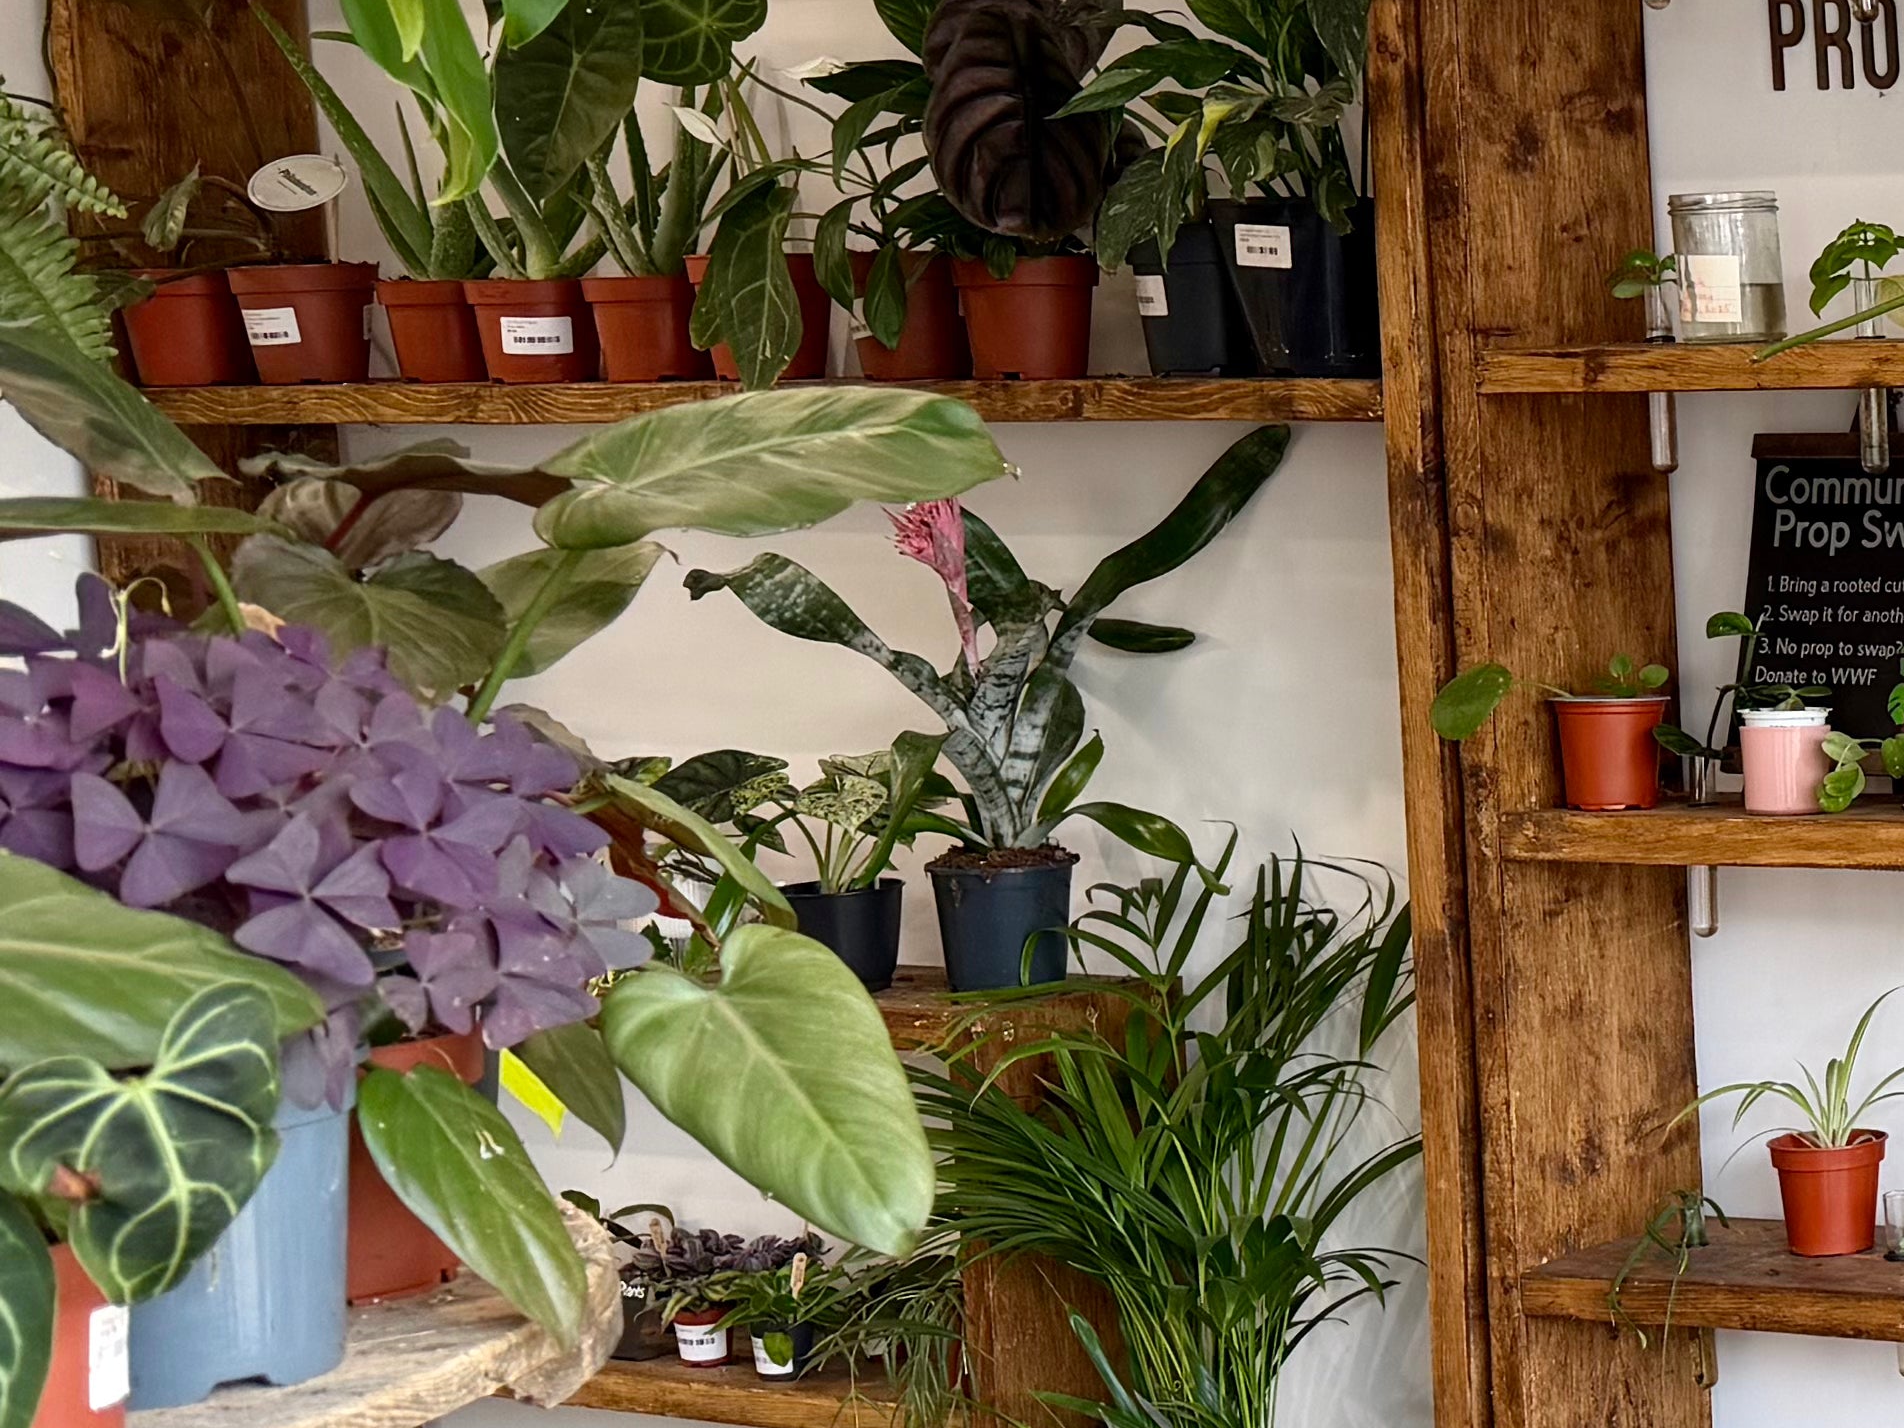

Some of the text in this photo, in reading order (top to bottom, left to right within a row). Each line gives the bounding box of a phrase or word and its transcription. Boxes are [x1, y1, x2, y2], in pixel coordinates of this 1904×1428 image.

[1773, 508, 1851, 557] Prop
[1779, 575, 1817, 597] Bring
[1820, 580, 1830, 593] a
[1833, 576, 1882, 593] rooted
[1763, 604, 1774, 622] 2.
[1778, 604, 1819, 625] Swap
[1822, 606, 1833, 622] it
[1837, 605, 1859, 623] for
[1758, 637, 1903, 660] 3. No prop to swap?
[1755, 665, 1878, 686] Donate to WWF
